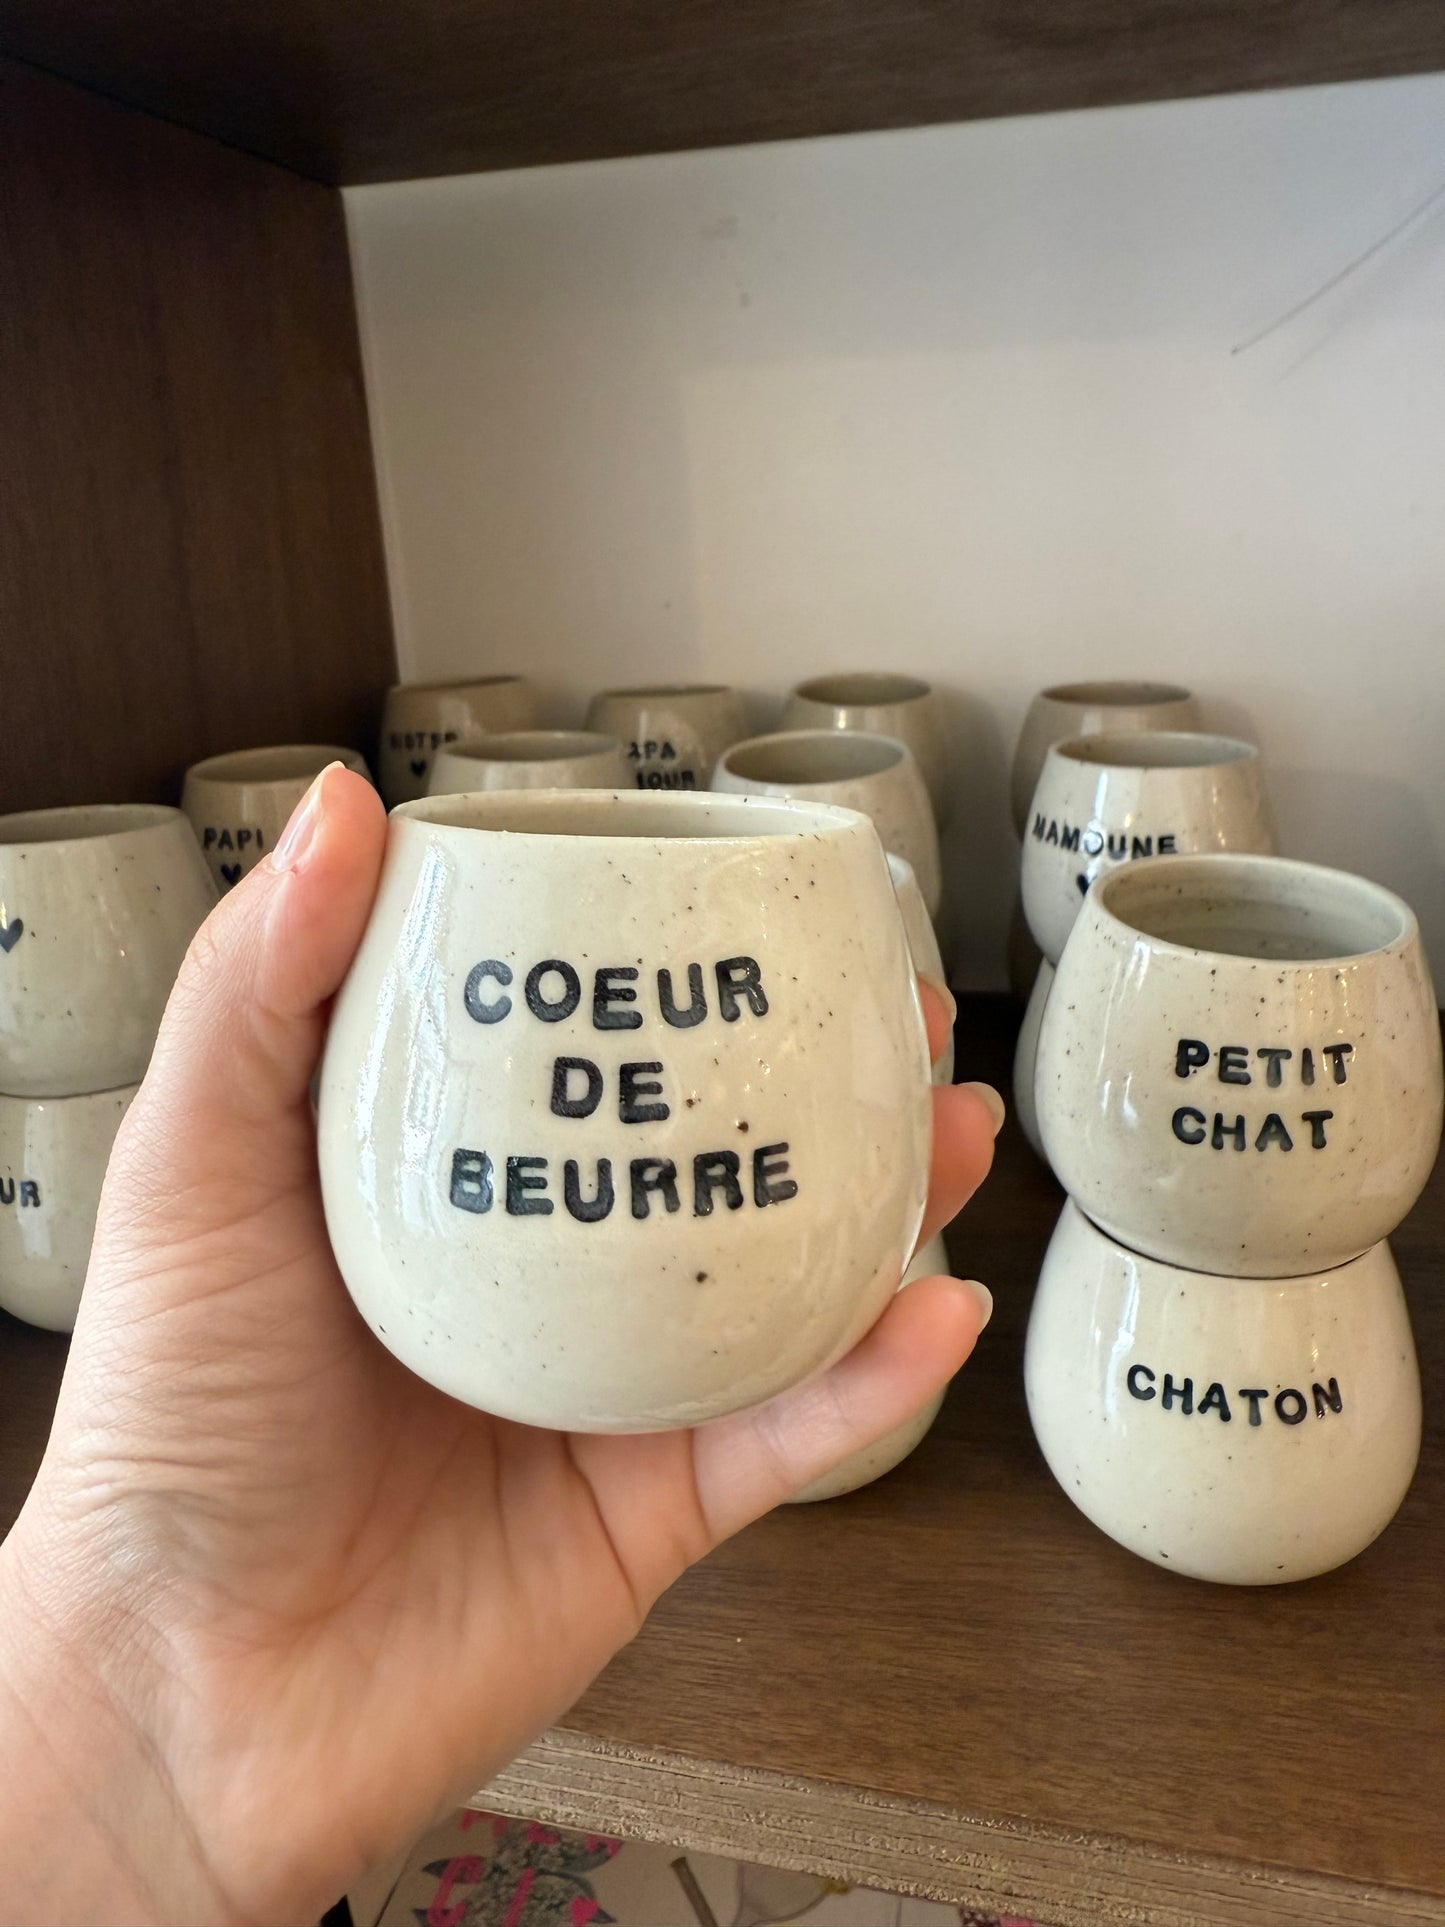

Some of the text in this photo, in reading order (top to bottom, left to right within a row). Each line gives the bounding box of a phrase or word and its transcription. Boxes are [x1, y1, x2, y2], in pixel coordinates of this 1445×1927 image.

[203, 827, 264, 851] PAPI
[1032, 812, 1178, 860] MAMOUNE
[463, 956, 769, 1030] COEUR
[550, 1056, 671, 1124] DE
[1174, 1038, 1354, 1089] PETIT
[1171, 1105, 1334, 1152] CHAT
[449, 1141, 799, 1224] BEURRE
[1126, 1363, 1344, 1427] CHATON
